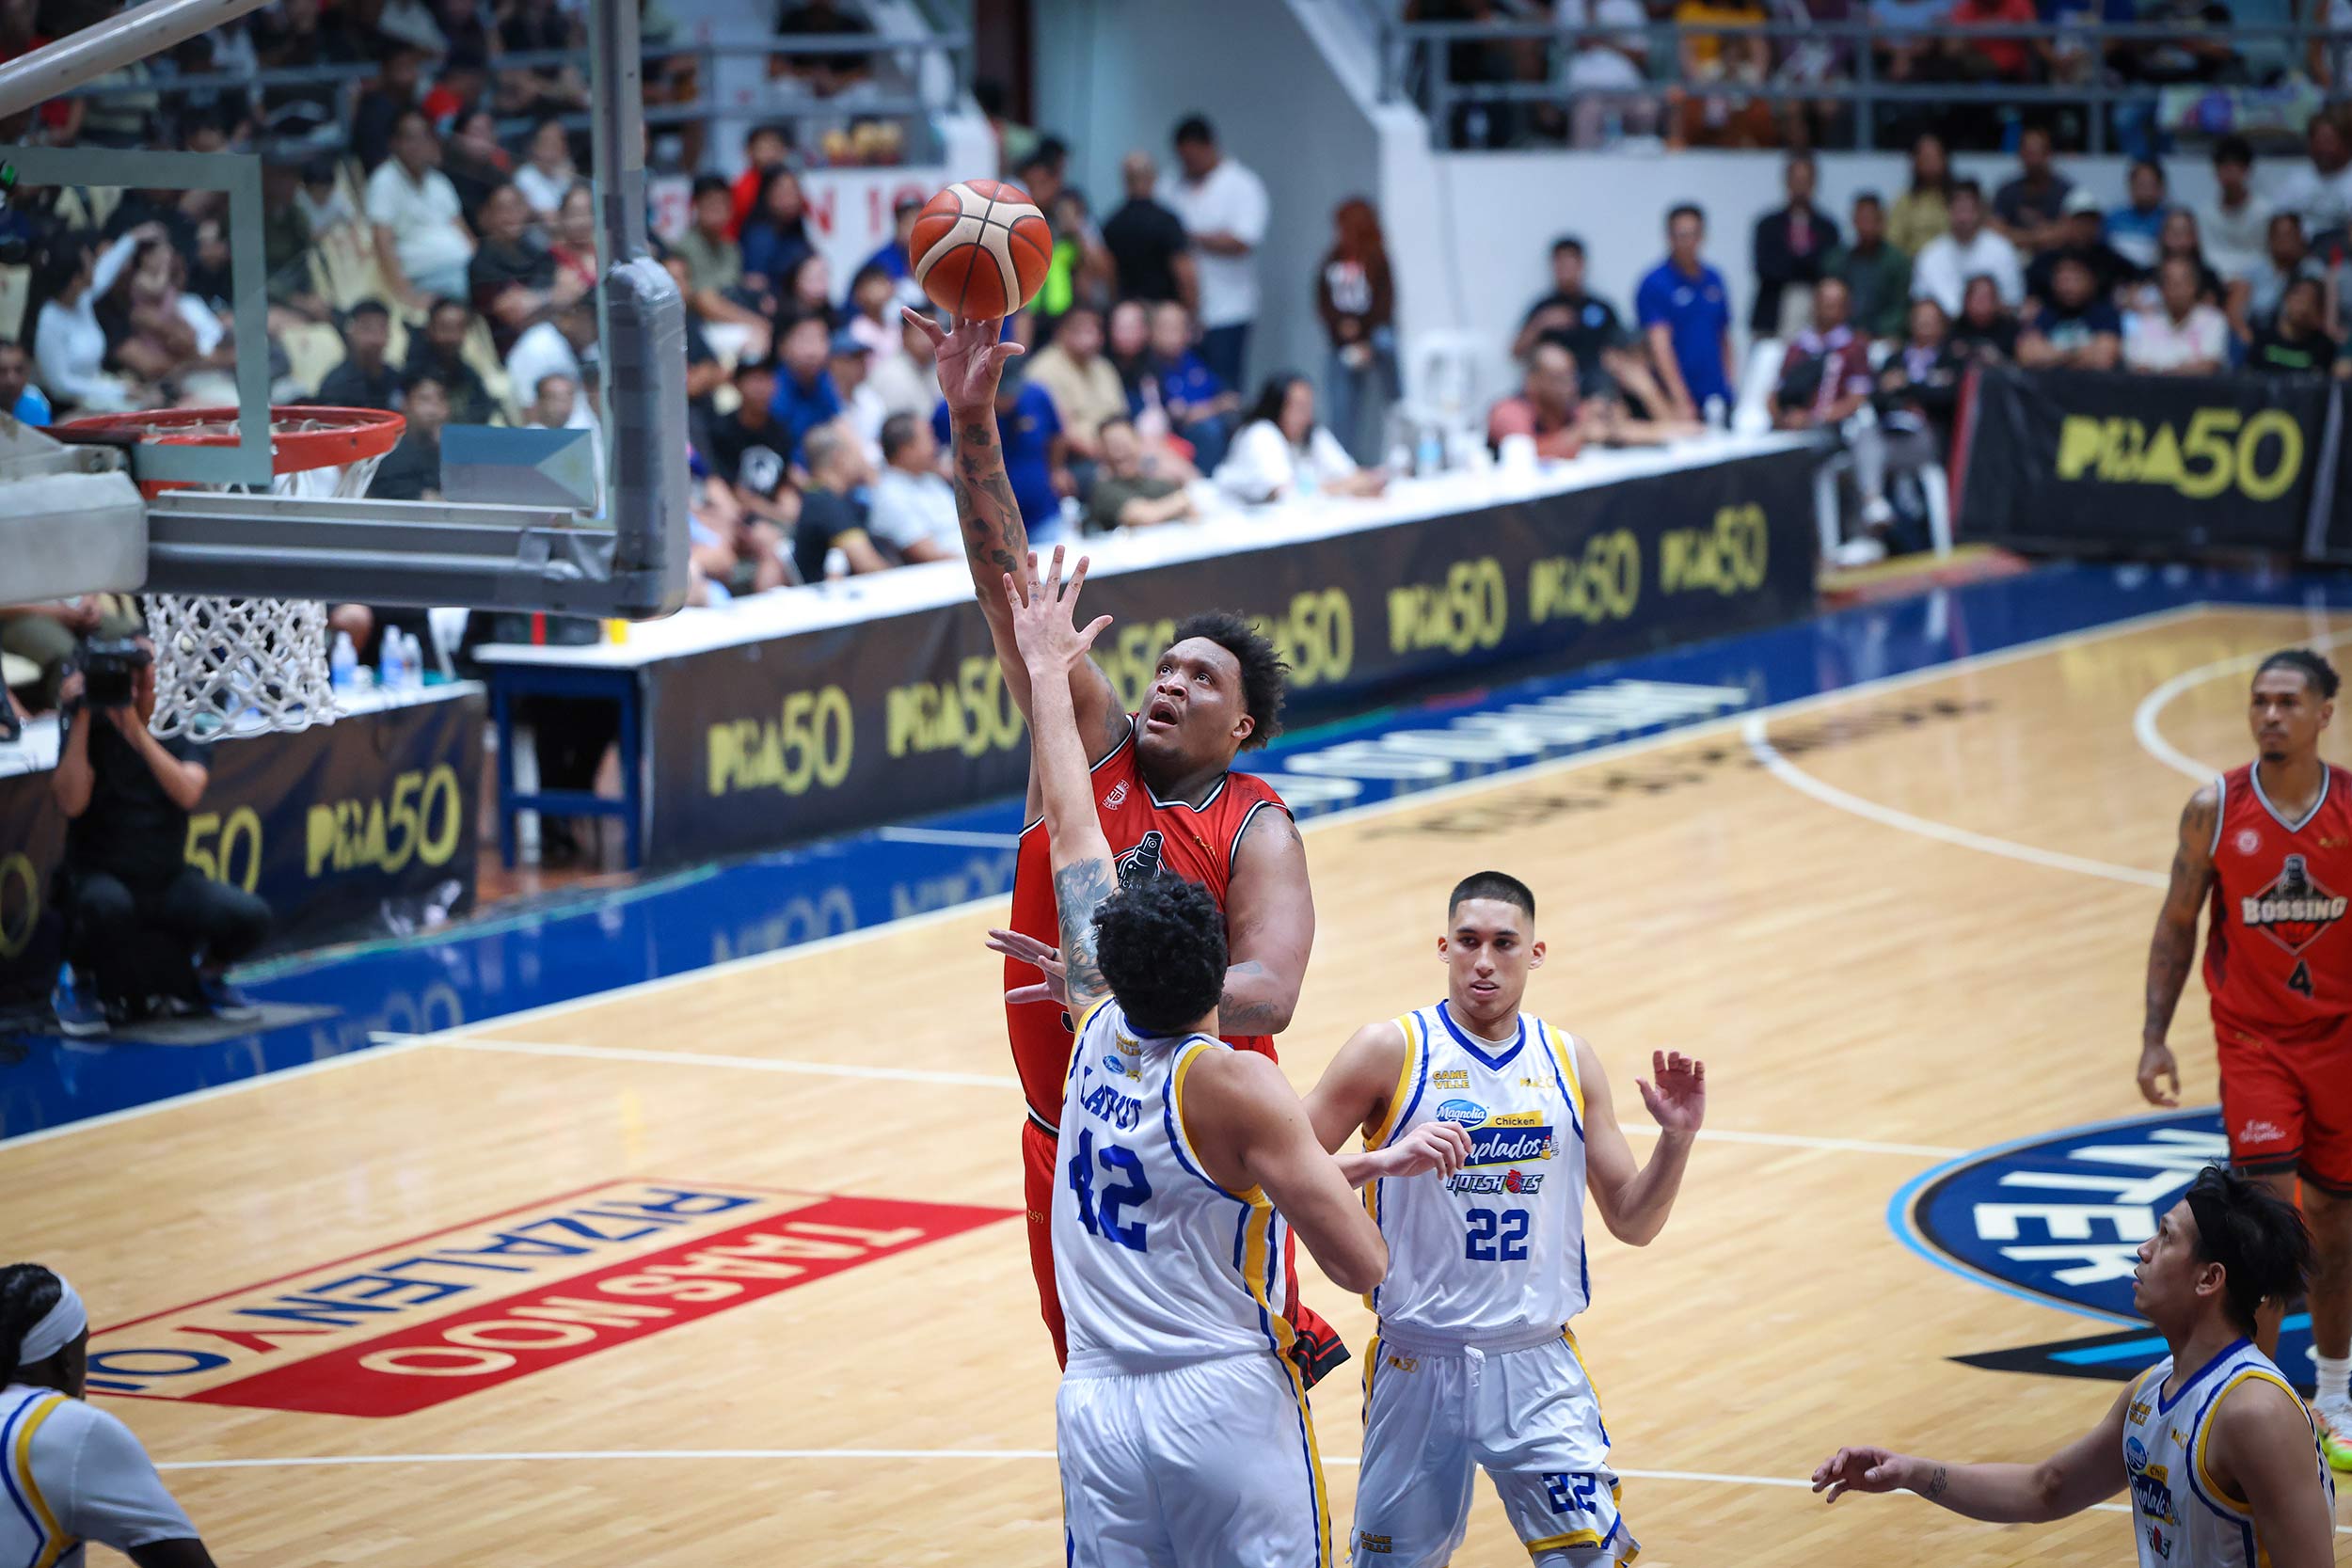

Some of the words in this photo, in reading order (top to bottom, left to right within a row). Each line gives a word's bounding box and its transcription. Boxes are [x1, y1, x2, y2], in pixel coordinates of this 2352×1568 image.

[2241, 895, 2348, 925] BOSSING
[2287, 959, 2314, 998] 4
[1433, 1069, 1468, 1080] GAME
[1433, 1080, 1470, 1089] VILLE
[1437, 1105, 1486, 1124] Magnolia
[1495, 1117, 1535, 1126] Chicken
[1468, 1132, 1543, 1165] mplados
[1069, 1127, 1152, 1253] 42
[1466, 1208, 1530, 1261] 22
[358, 1296, 675, 1377] NOO
[1542, 1472, 1597, 1515] 22
